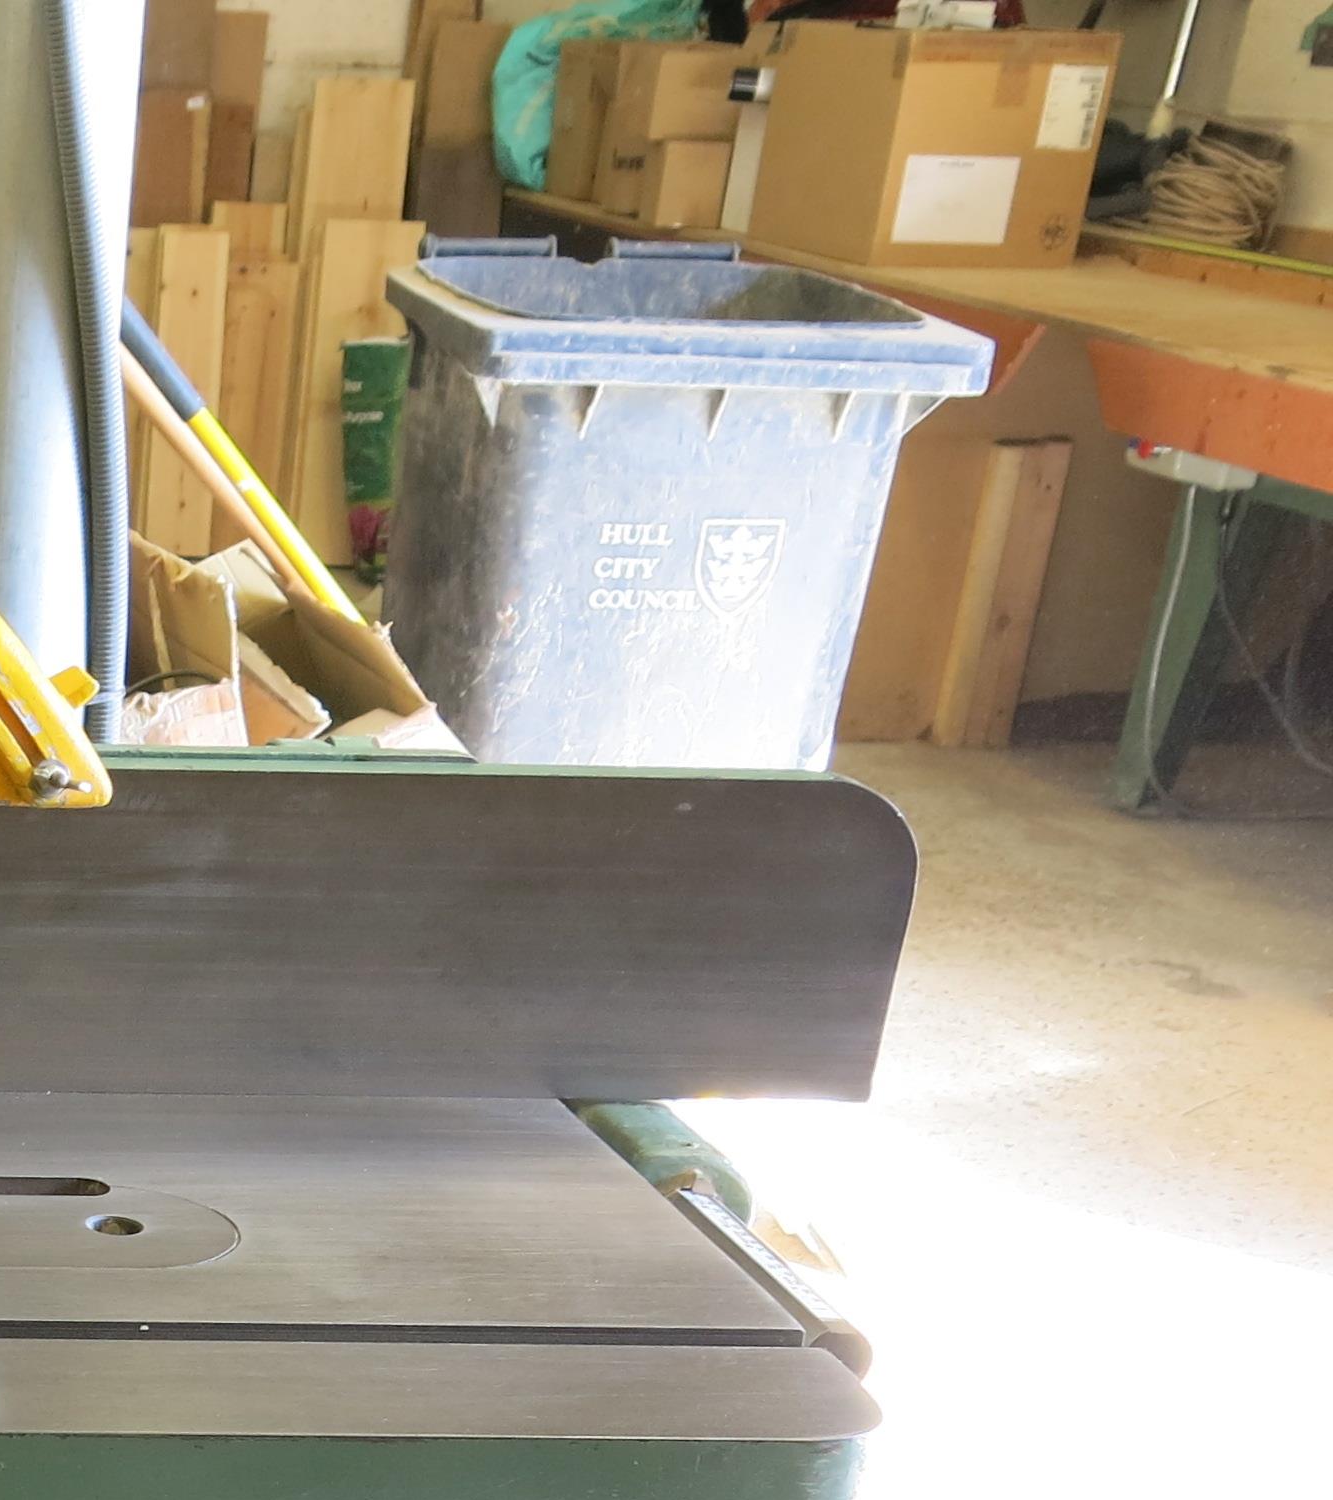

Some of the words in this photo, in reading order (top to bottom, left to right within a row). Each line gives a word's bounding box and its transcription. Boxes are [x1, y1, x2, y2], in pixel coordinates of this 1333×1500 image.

[599, 523, 673, 546] HULL
[594, 557, 661, 580] CITY
[588, 588, 702, 612] COUNCIL
